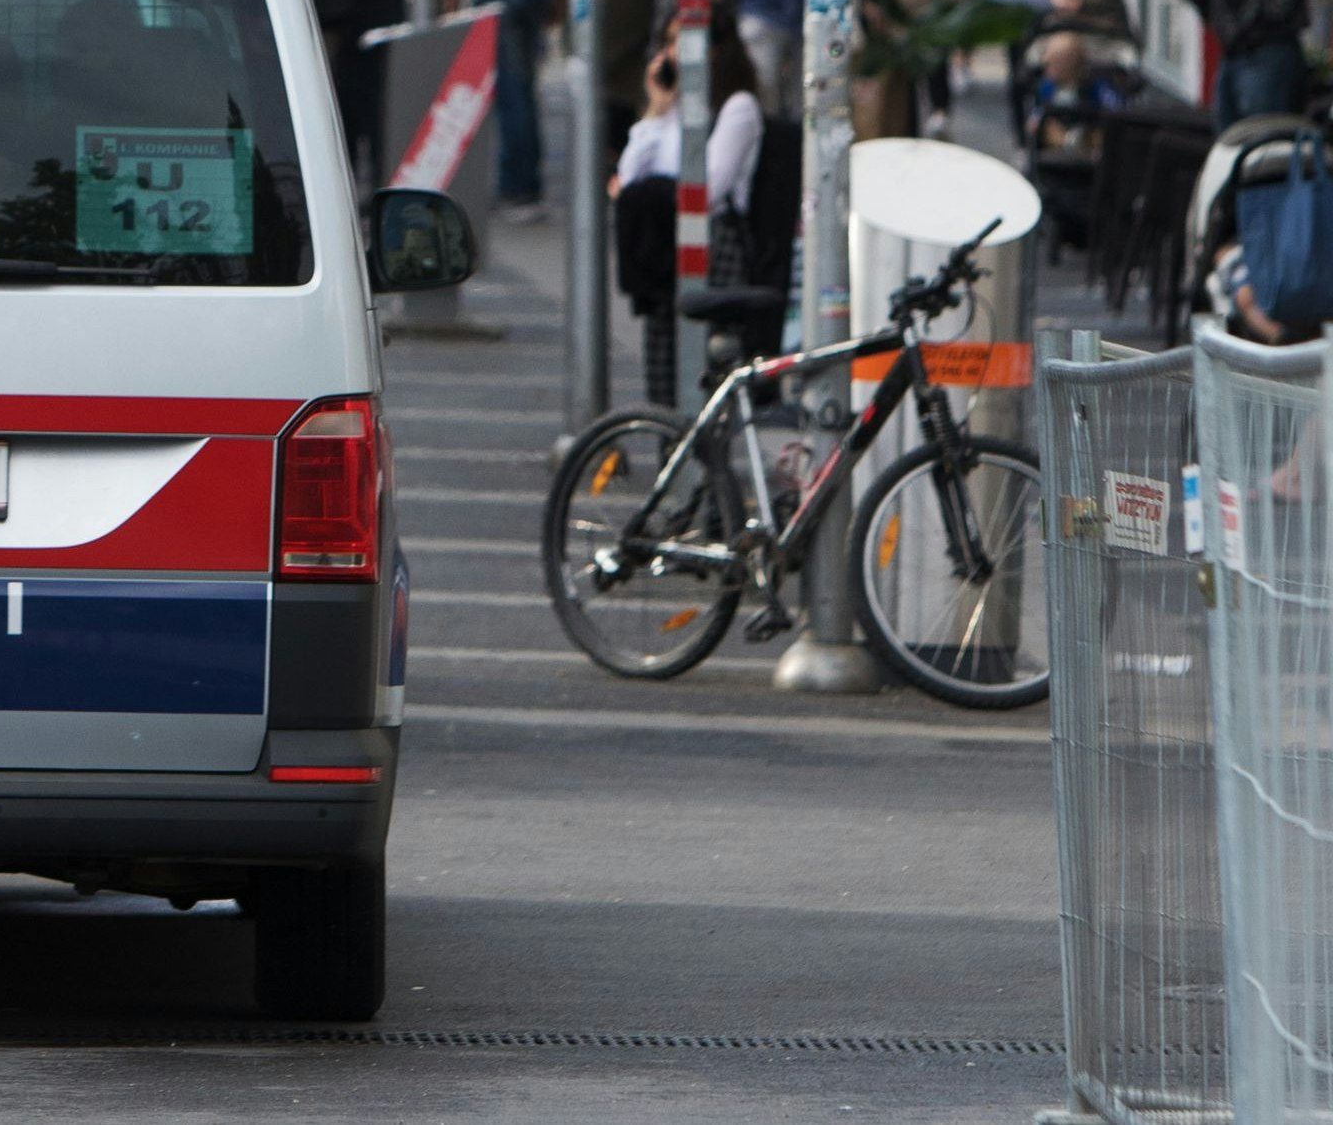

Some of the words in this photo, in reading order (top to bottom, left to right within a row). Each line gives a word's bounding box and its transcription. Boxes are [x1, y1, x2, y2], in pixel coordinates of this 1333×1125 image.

[135, 144, 221, 156] KOMPANIE
[136, 162, 184, 192] U
[112, 197, 212, 233] 112
